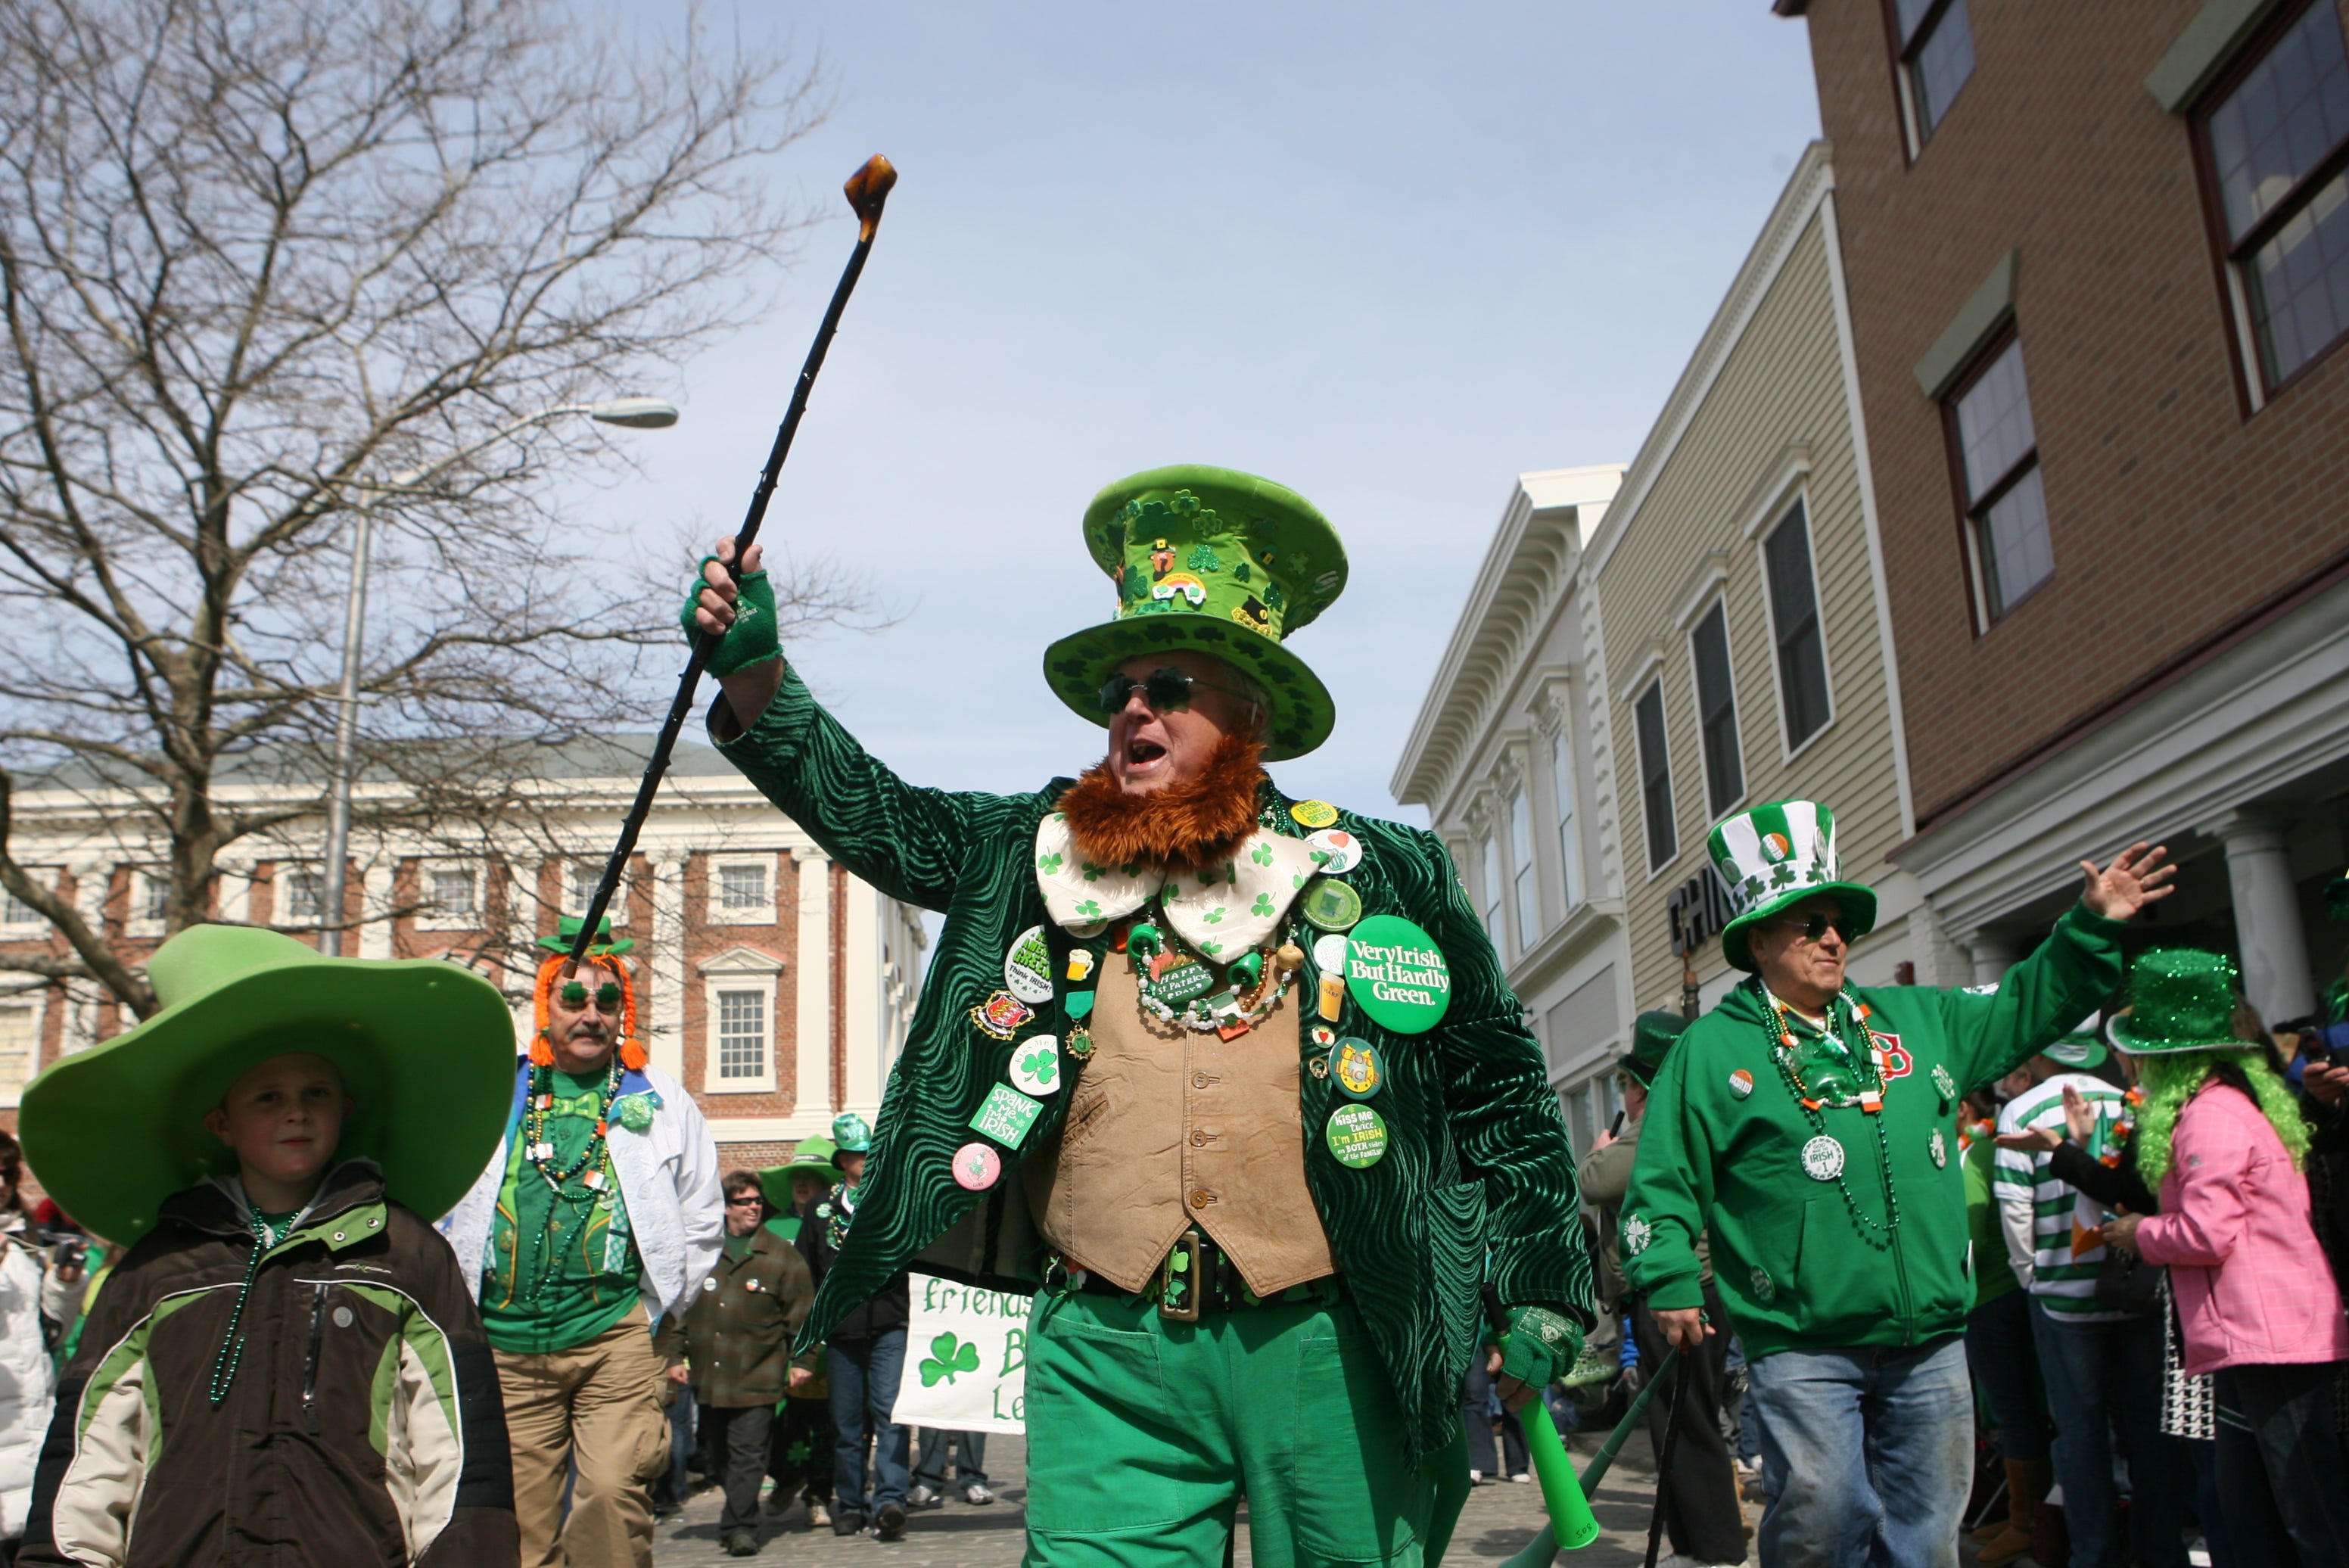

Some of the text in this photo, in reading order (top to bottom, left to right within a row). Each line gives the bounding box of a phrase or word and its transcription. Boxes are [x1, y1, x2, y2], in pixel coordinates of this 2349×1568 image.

[1013, 947, 1052, 982] GREEN
[1349, 940, 1395, 964] Very
[1394, 945, 1445, 971] Irish,
[1009, 964, 1053, 993] Think IRISH!
[1159, 966, 1203, 985] HAPPY
[1349, 960, 1450, 993] But Hardly
[1324, 988, 1339, 998] HARP
[1372, 982, 1436, 1006] Green.
[978, 1115, 1019, 1143] IRISH
[1332, 1136, 1350, 1146] I'm
[1346, 1141, 1368, 1153] BOTH
[1809, 1150, 1834, 1164] IRISH
